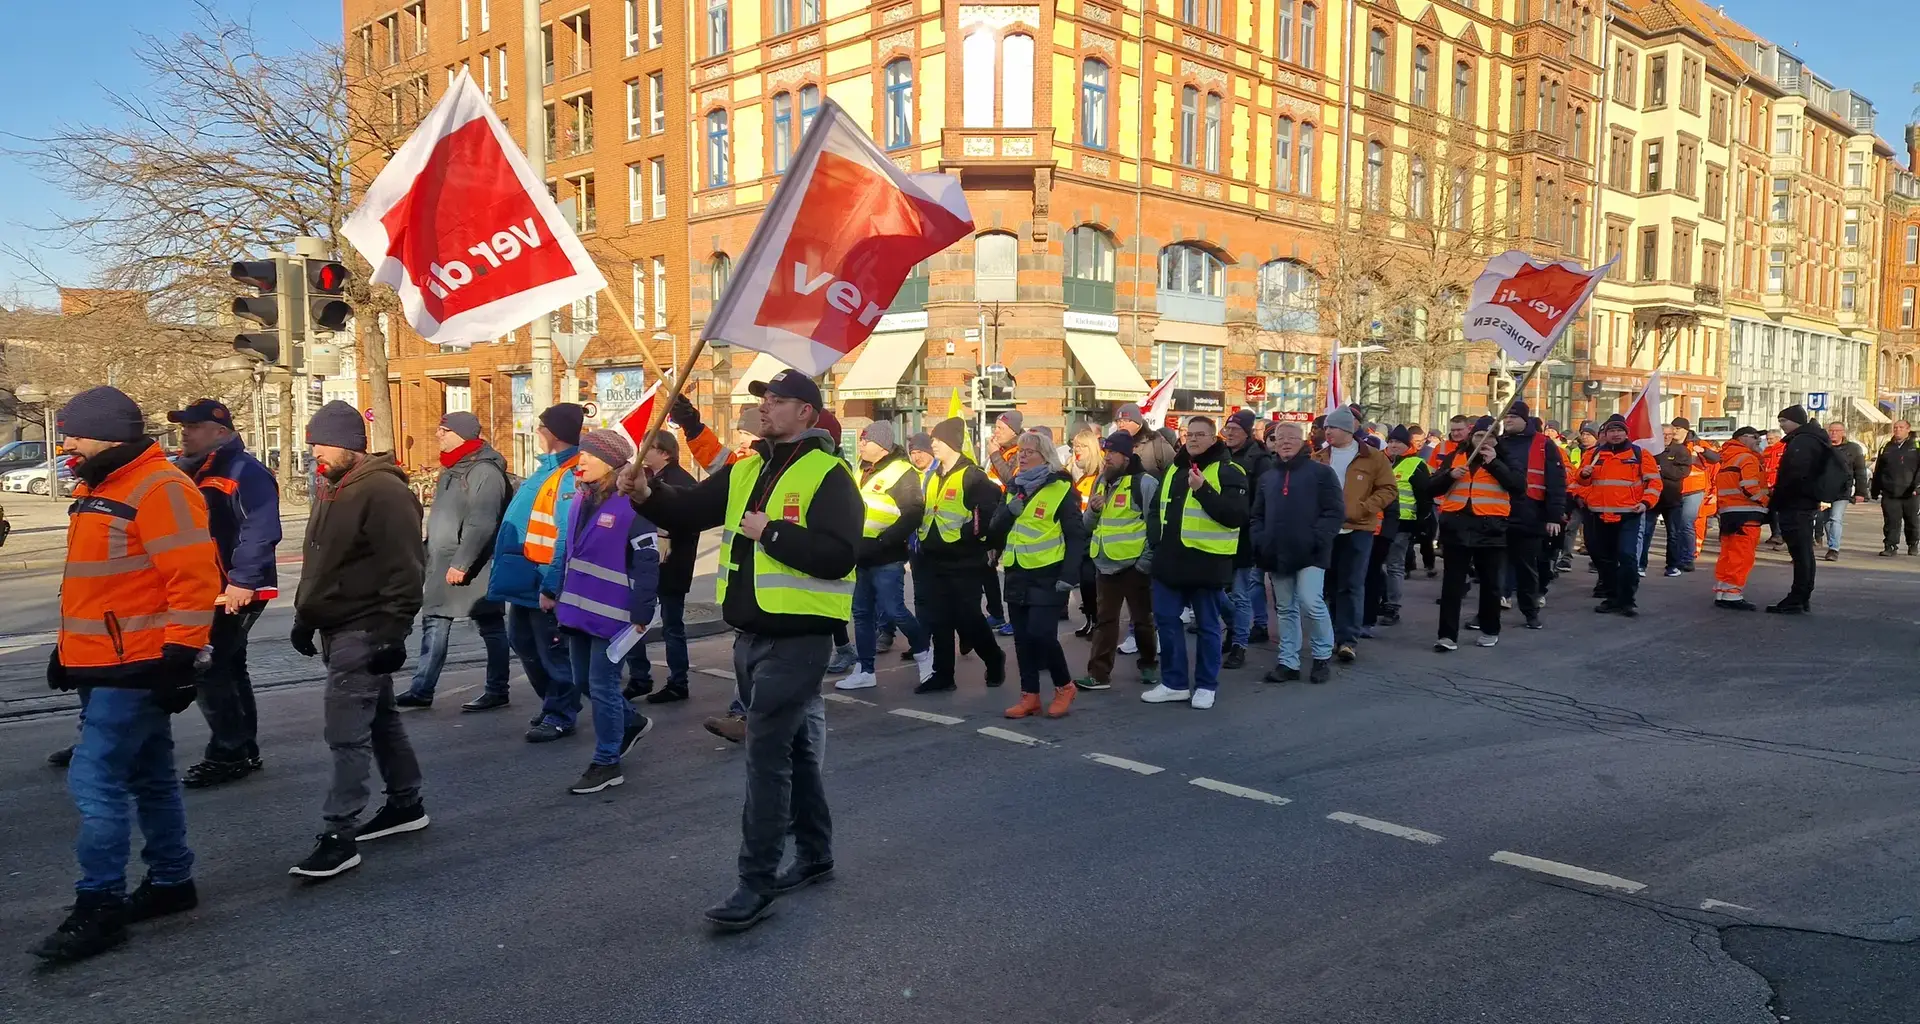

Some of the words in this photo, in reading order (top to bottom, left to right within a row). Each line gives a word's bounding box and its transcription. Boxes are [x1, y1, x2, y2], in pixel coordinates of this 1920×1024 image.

[606, 389, 624, 401] Das
[625, 388, 642, 401] Bett
[1808, 394, 1822, 409] U
